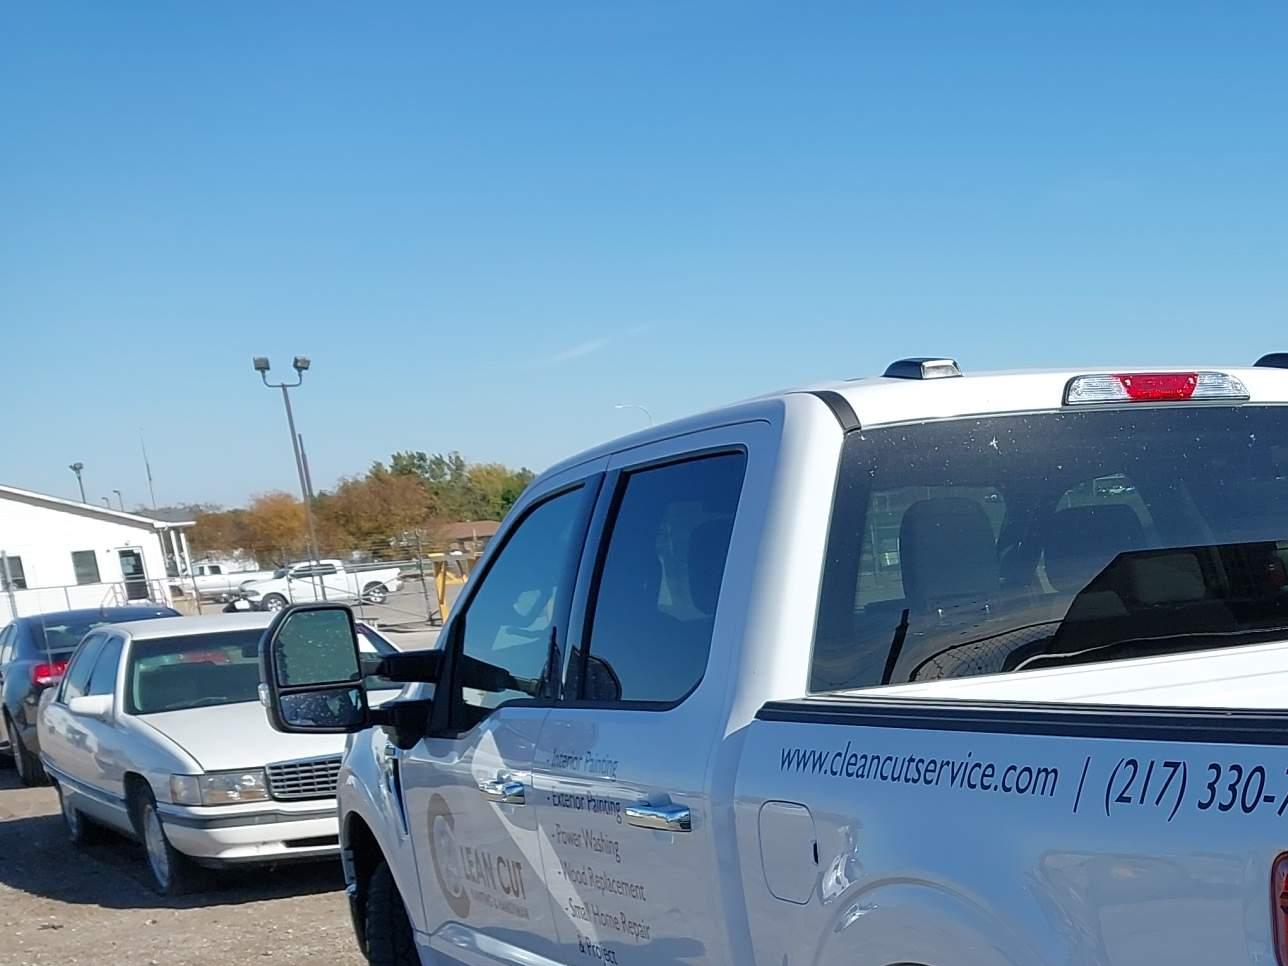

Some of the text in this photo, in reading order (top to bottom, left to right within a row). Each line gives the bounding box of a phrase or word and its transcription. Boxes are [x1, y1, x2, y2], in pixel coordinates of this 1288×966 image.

[584, 751, 618, 782] Painting
[779, 741, 1058, 797] www.cleancutservice.com
[1105, 758, 1188, 822] (217)
[552, 786, 623, 824] Exterior Painting
[555, 823, 621, 863] Power Washing
[496, 855, 527, 900] CUT
[560, 859, 647, 902] Wood Replacement
[591, 904, 621, 931] Home
[619, 911, 650, 943] Repair
[584, 936, 619, 966] Project
